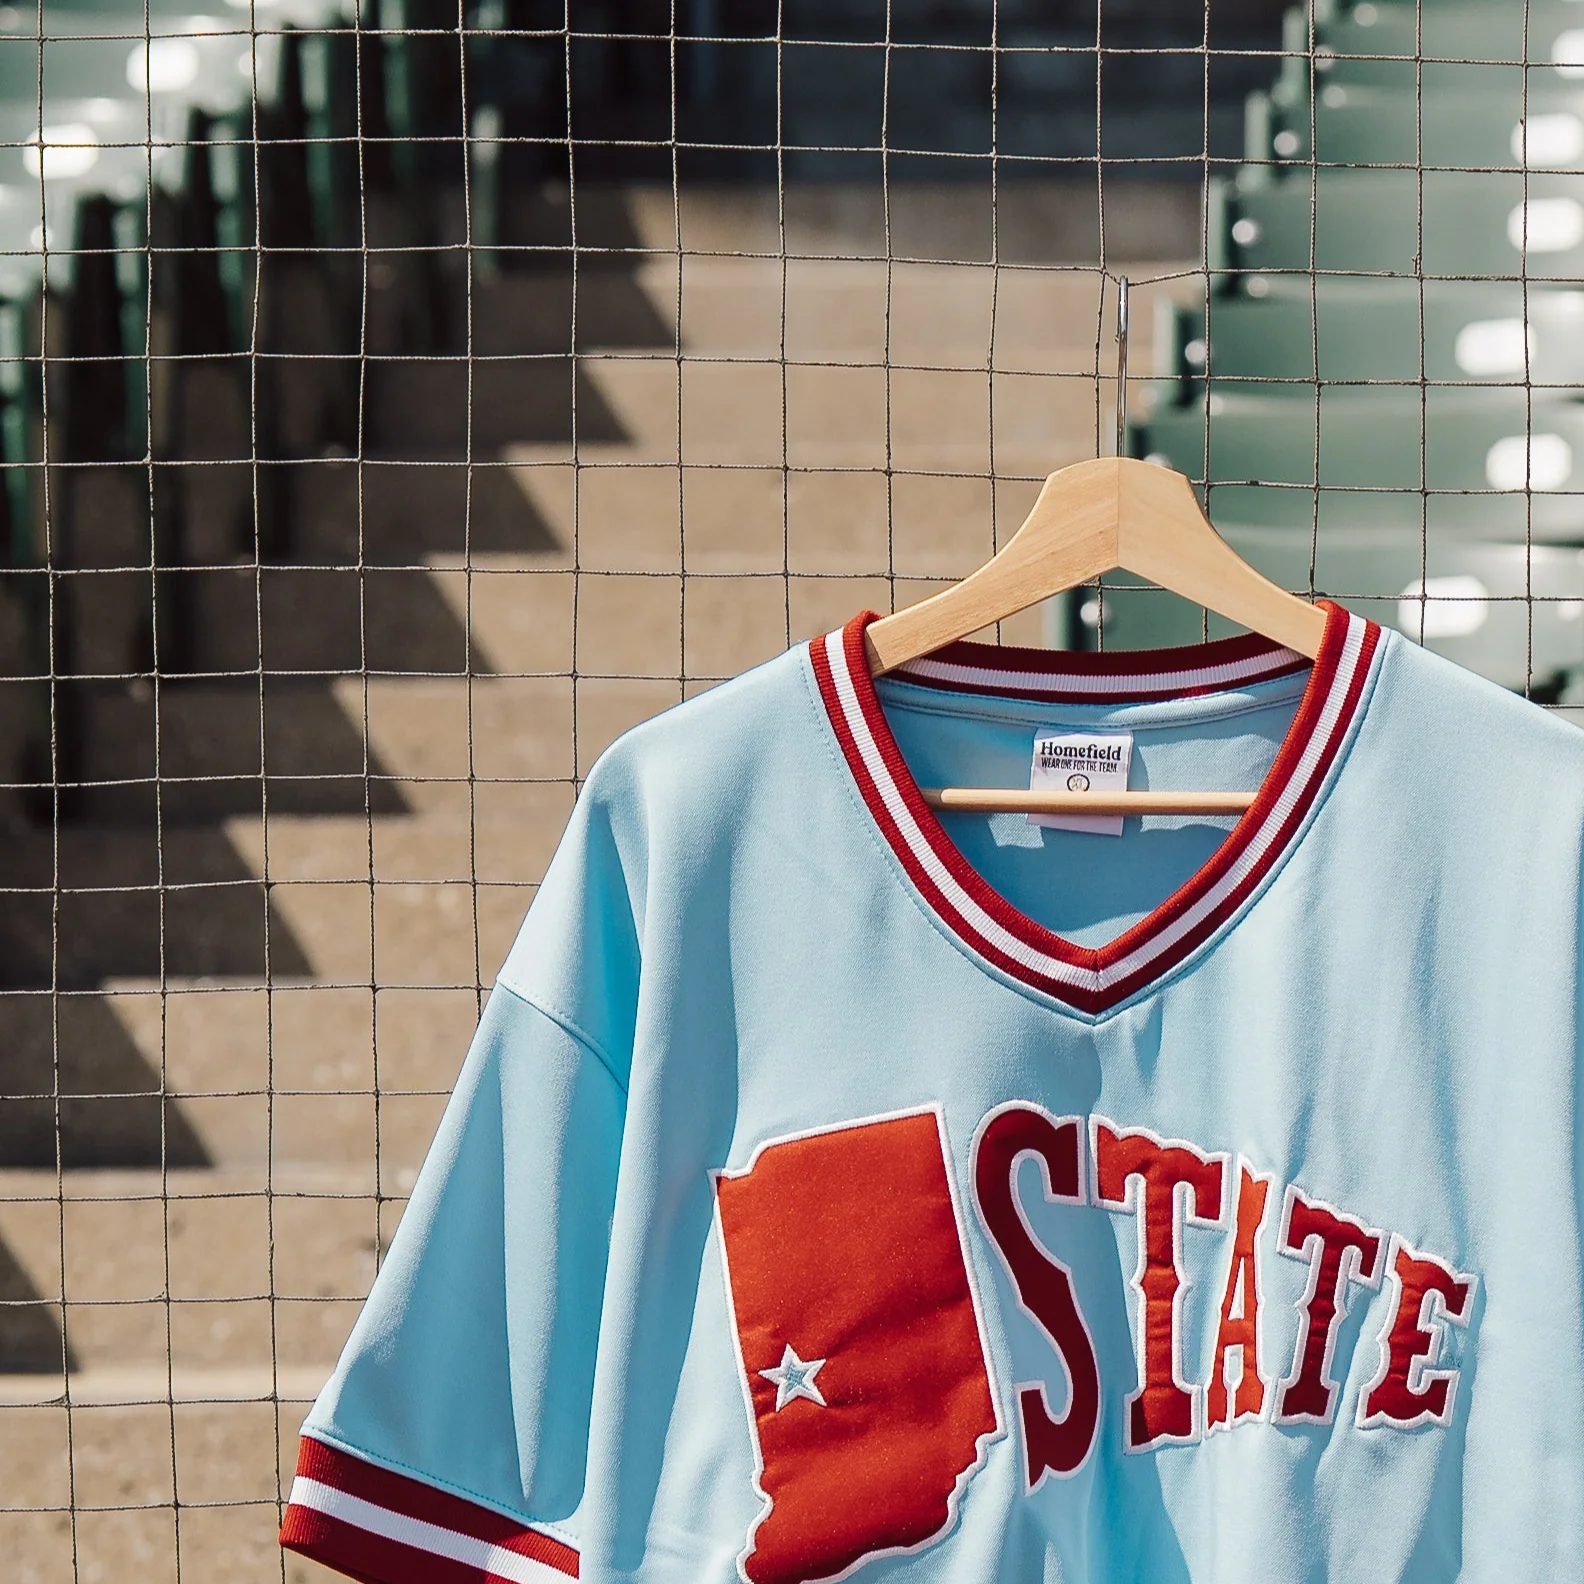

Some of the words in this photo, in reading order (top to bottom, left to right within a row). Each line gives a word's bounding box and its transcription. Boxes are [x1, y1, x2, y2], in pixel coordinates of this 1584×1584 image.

[1041, 742, 1121, 761] Homefield
[1041, 757, 1060, 769] WEAR
[1061, 759, 1072, 770] ONE
[1073, 760, 1085, 771] FOR
[1086, 761, 1097, 772] THE
[970, 1098, 1479, 1497] STATE
